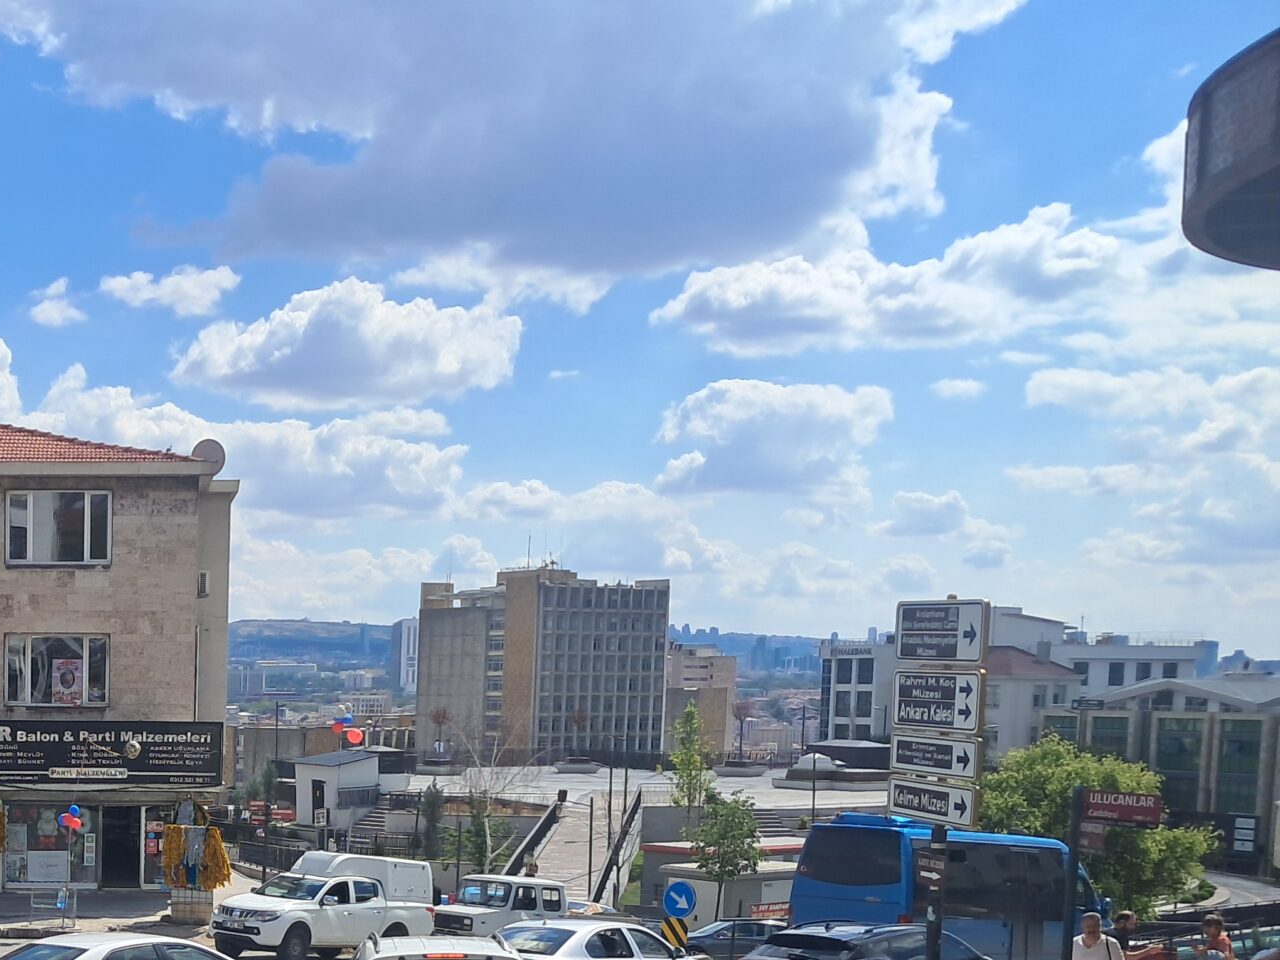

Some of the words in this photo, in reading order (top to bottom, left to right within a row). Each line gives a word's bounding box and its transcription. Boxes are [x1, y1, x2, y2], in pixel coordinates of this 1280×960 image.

[900, 676, 926, 686] Rahmi
[928, 678, 937, 686] M.
[940, 678, 955, 688] Koç
[912, 689, 941, 699] Müzesi
[899, 702, 928, 720] Ankara
[930, 704, 954, 722] Kalesi
[16, 730, 59, 742] Balon
[63, 730, 74, 742] &
[120, 731, 211, 744] Malzemeleri
[894, 787, 920, 807] Kelime
[920, 792, 948, 814] Müzesi
[1089, 792, 1155, 808] ULUCANLAR
[1087, 808, 1119, 819] Caddesi
